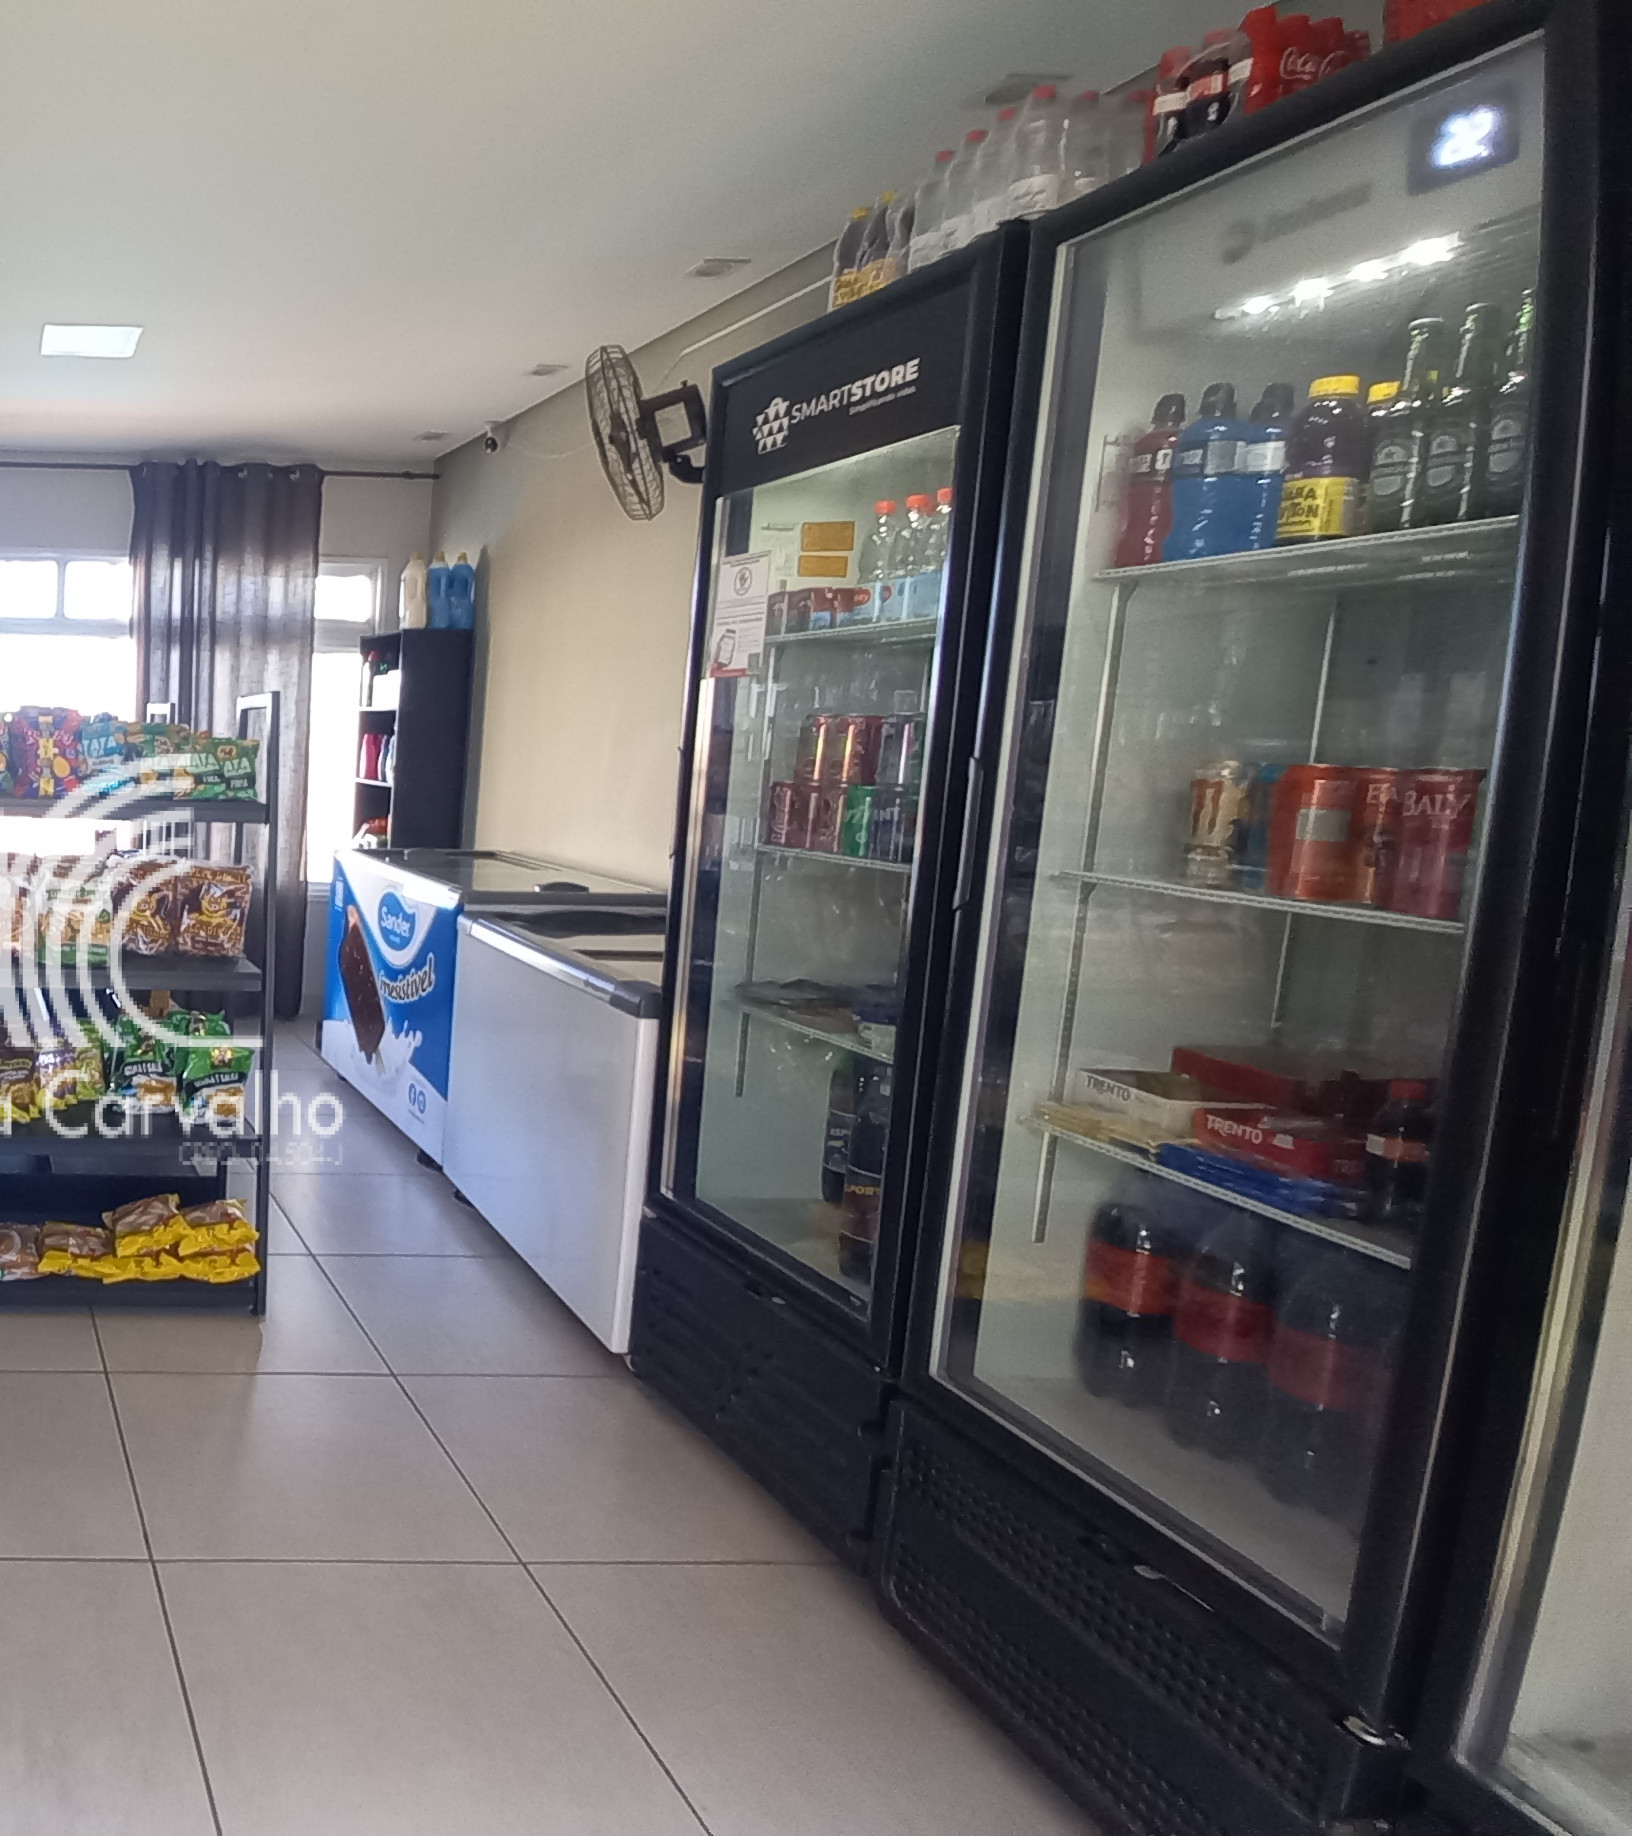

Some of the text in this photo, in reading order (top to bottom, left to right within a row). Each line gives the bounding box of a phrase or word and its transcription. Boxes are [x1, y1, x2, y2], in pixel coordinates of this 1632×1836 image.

[790, 357, 921, 424] SMARTSTORE
[1085, 1074, 1132, 1102] TRENTO
[1205, 1113, 1264, 1145] TRENTO
